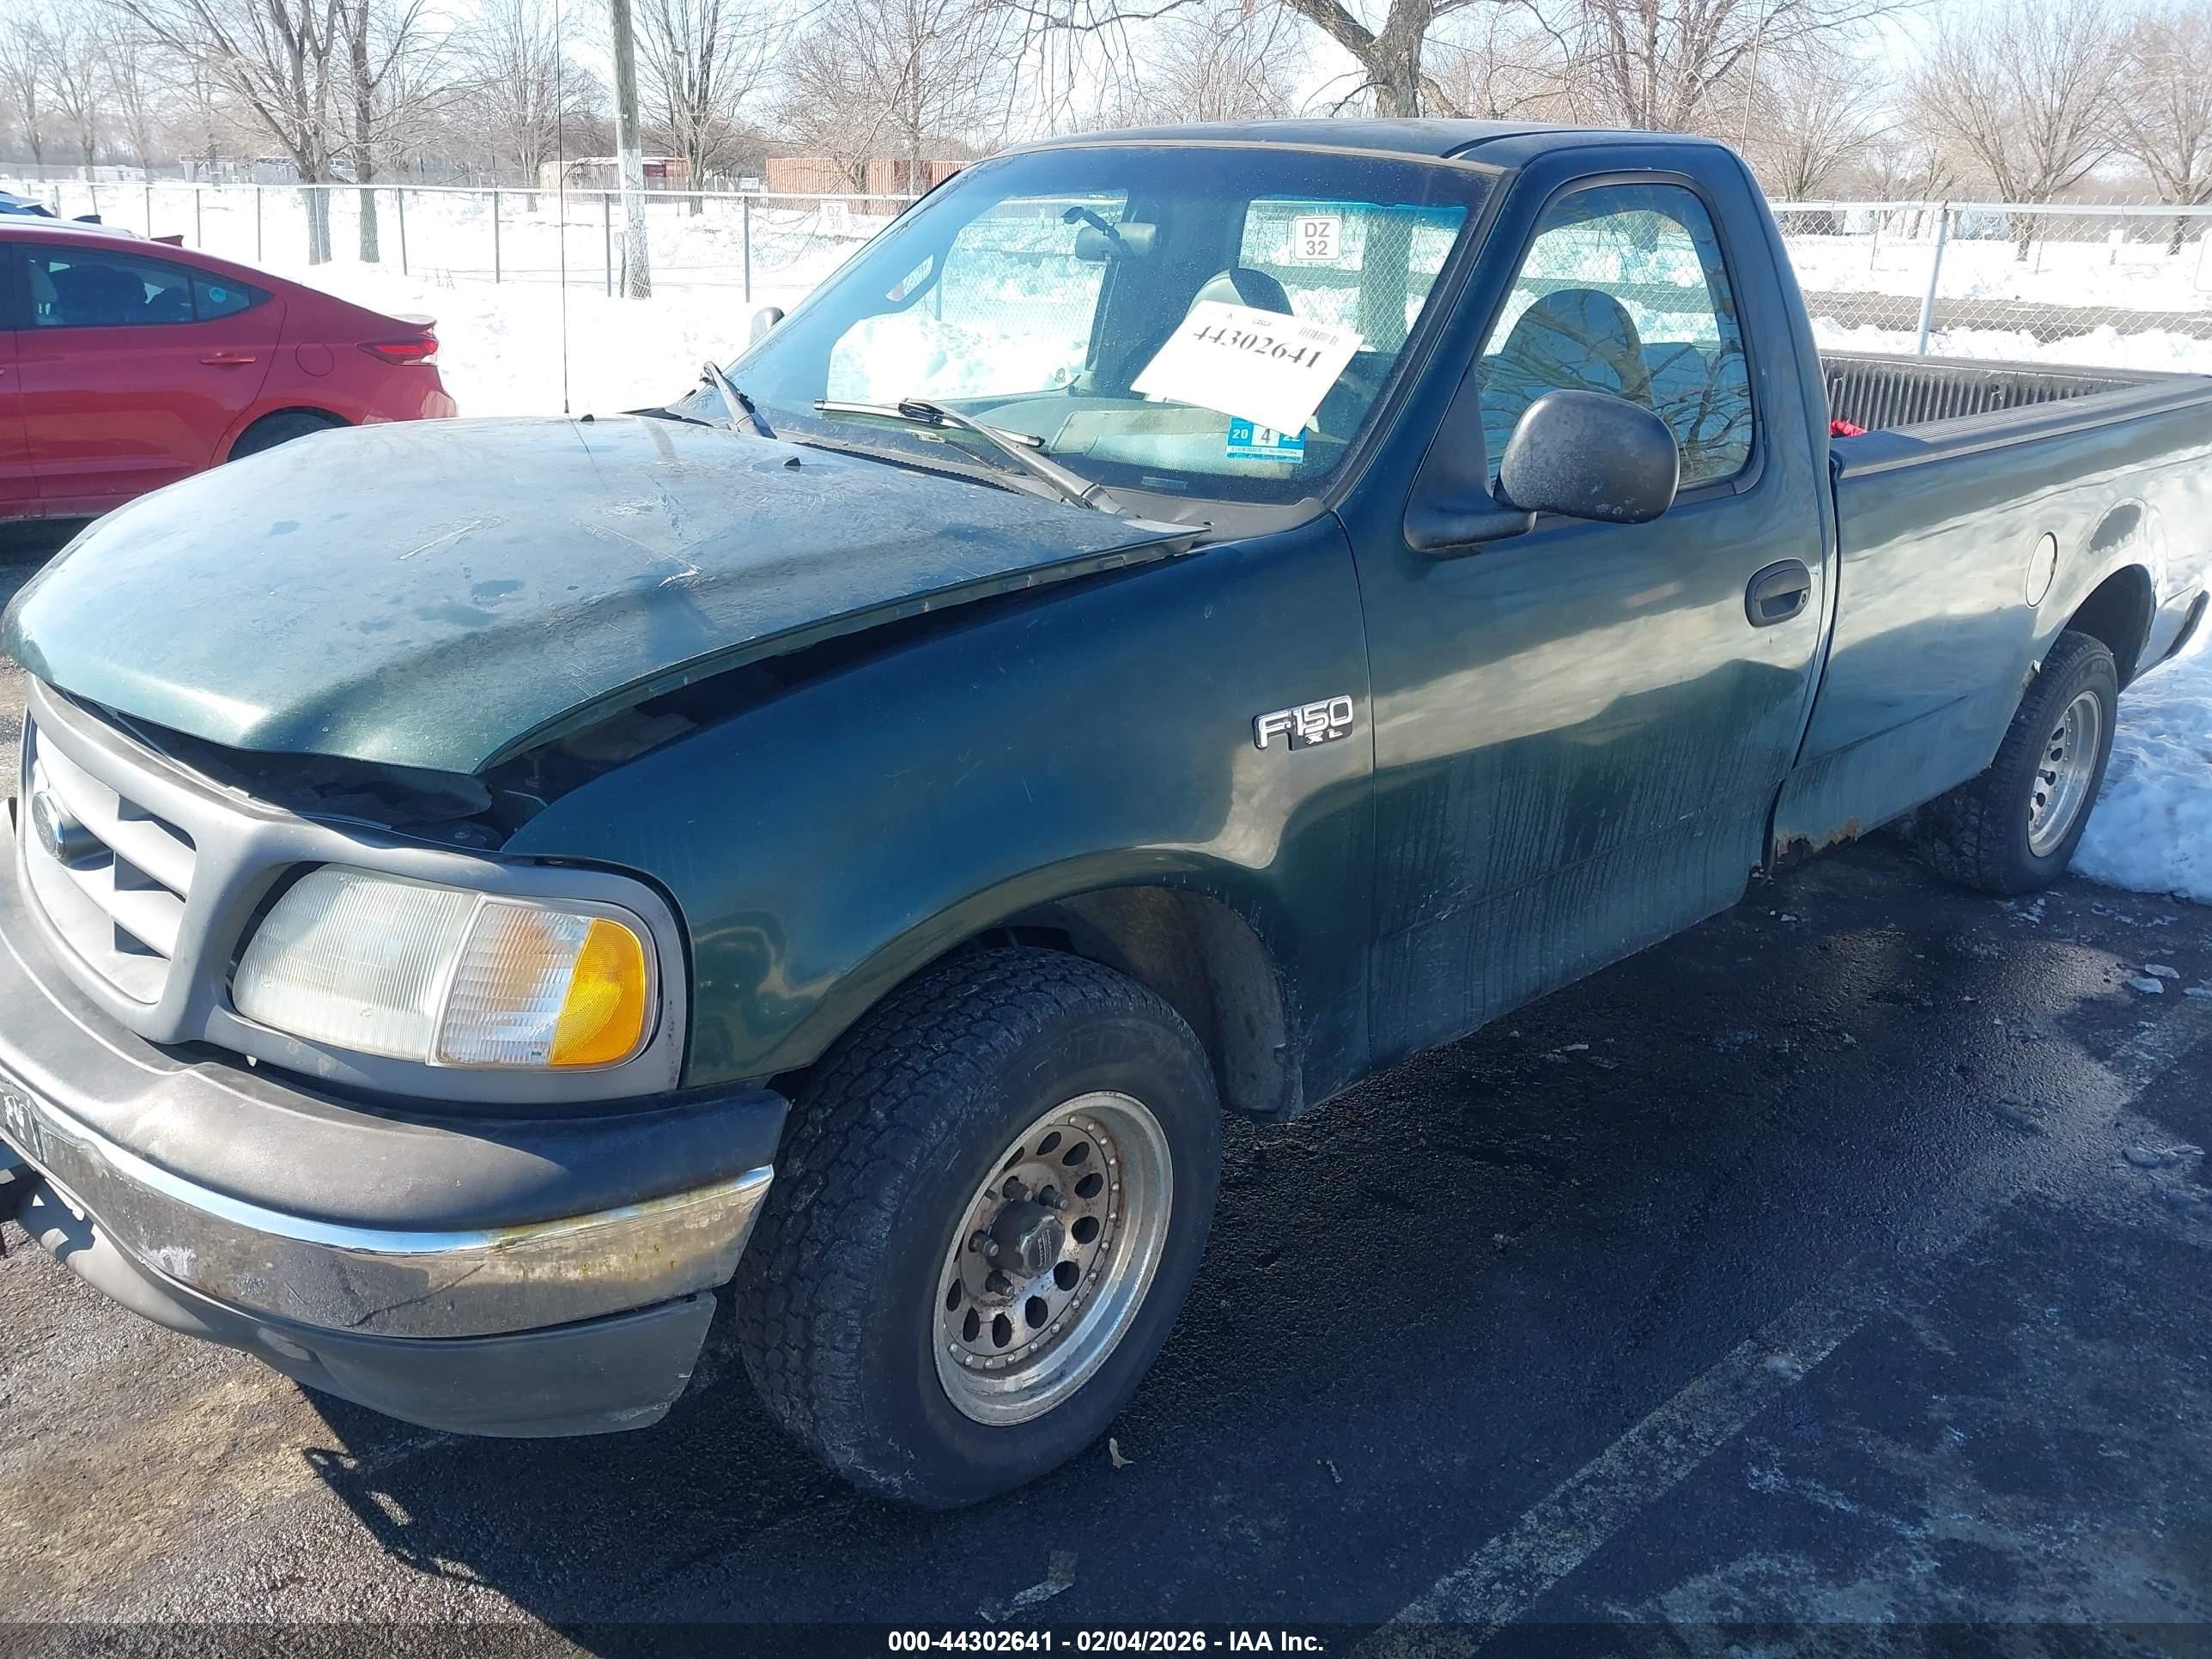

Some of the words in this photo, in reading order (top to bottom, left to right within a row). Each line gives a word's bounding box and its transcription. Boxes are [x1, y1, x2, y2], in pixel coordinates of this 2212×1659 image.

[828, 205, 842, 217] DZ
[1304, 222, 1330, 237] DZ
[1306, 240, 1328, 255] 32
[1193, 325, 1322, 368] 44302641
[1231, 428, 1249, 439] 20
[1261, 428, 1271, 444] 4
[1305, 729, 1343, 744] XL
